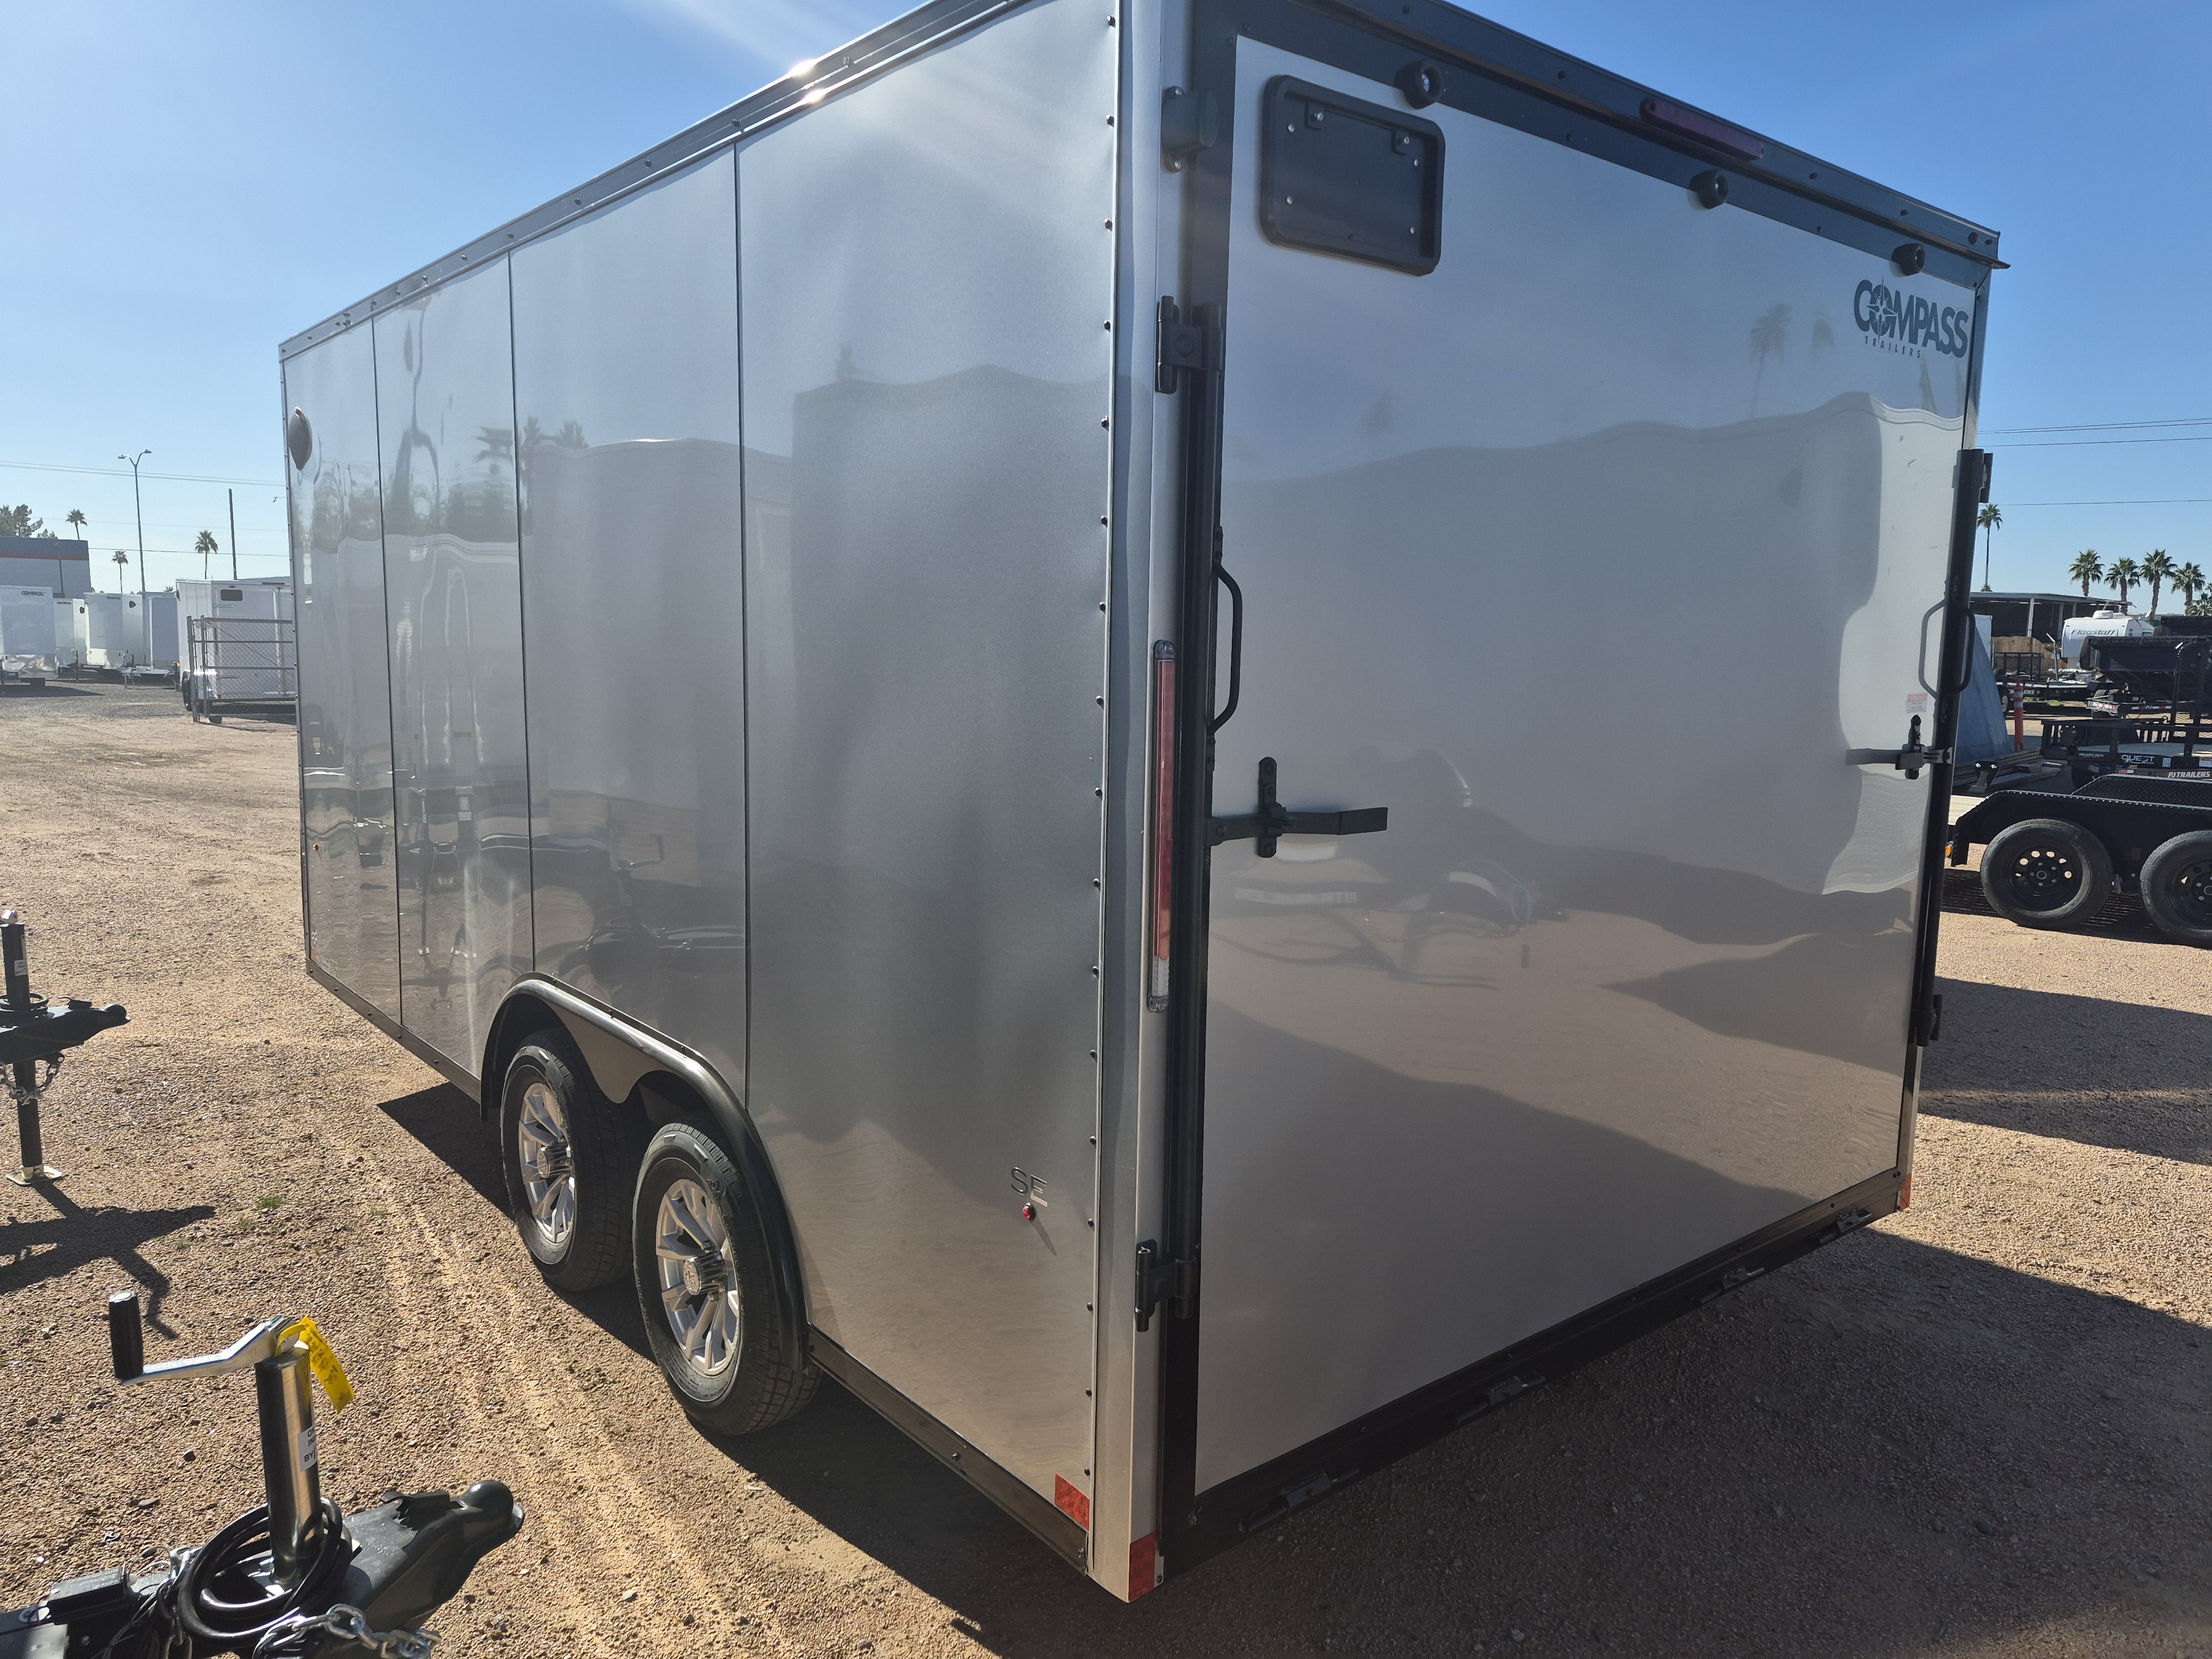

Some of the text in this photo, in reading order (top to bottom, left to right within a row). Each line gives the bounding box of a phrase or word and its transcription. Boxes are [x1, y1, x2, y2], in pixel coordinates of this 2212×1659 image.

[1854, 278, 1969, 358] COMPASS
[1865, 335, 1921, 358] TRAILERS
[1011, 1167, 1048, 1207] SE
[304, 1451, 313, 1462] BY
